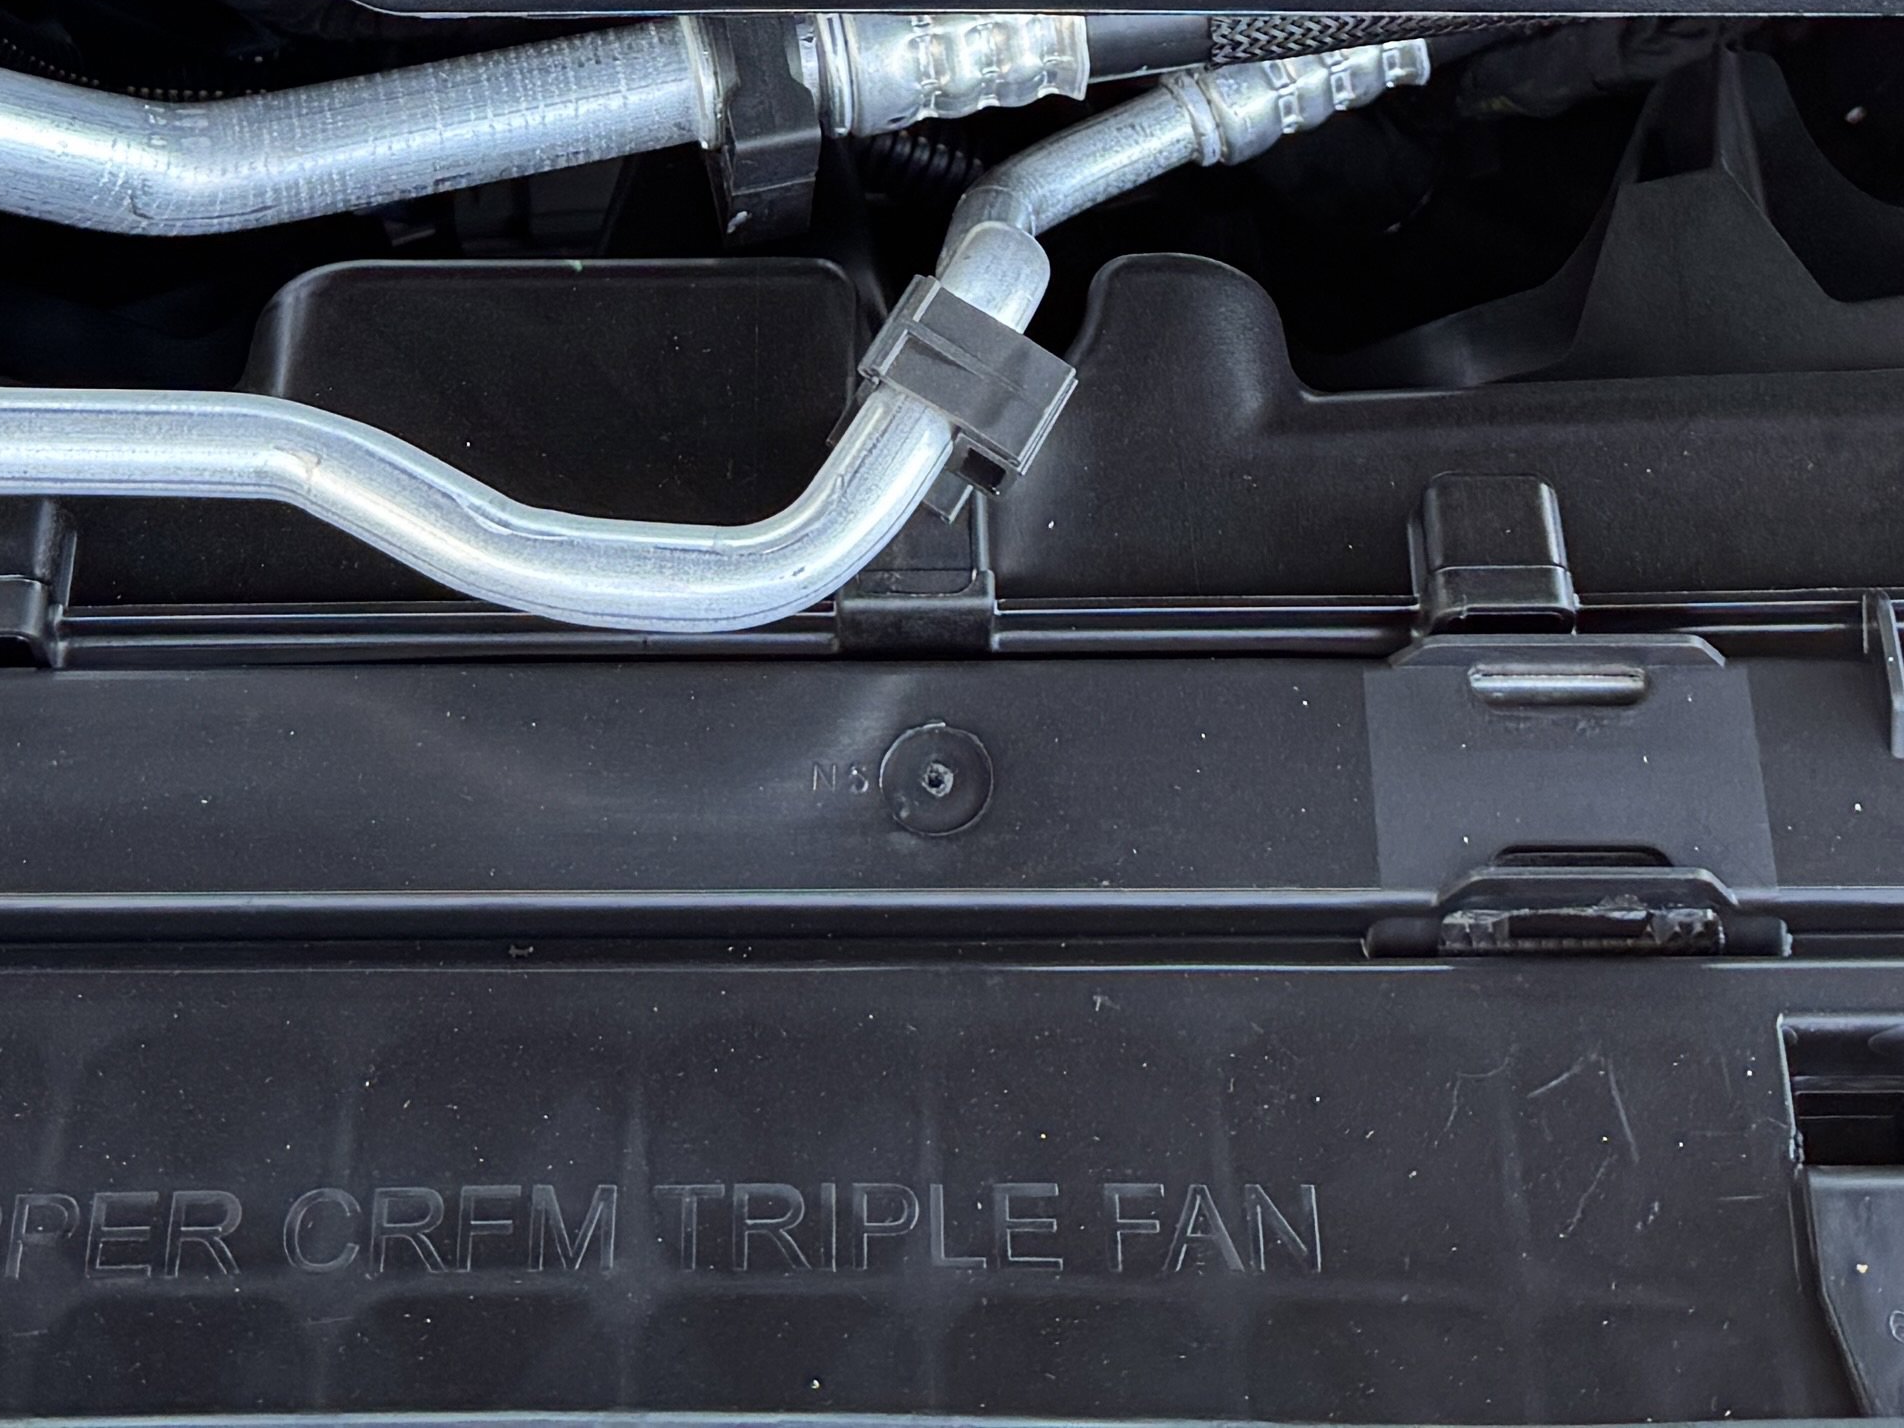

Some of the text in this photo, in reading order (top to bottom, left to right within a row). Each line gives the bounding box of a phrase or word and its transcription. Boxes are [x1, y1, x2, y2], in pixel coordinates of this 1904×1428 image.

[283, 1182, 617, 1276] CRFM
[654, 1180, 1064, 1274] TRIPLE
[1105, 1180, 1322, 1276] FAN
